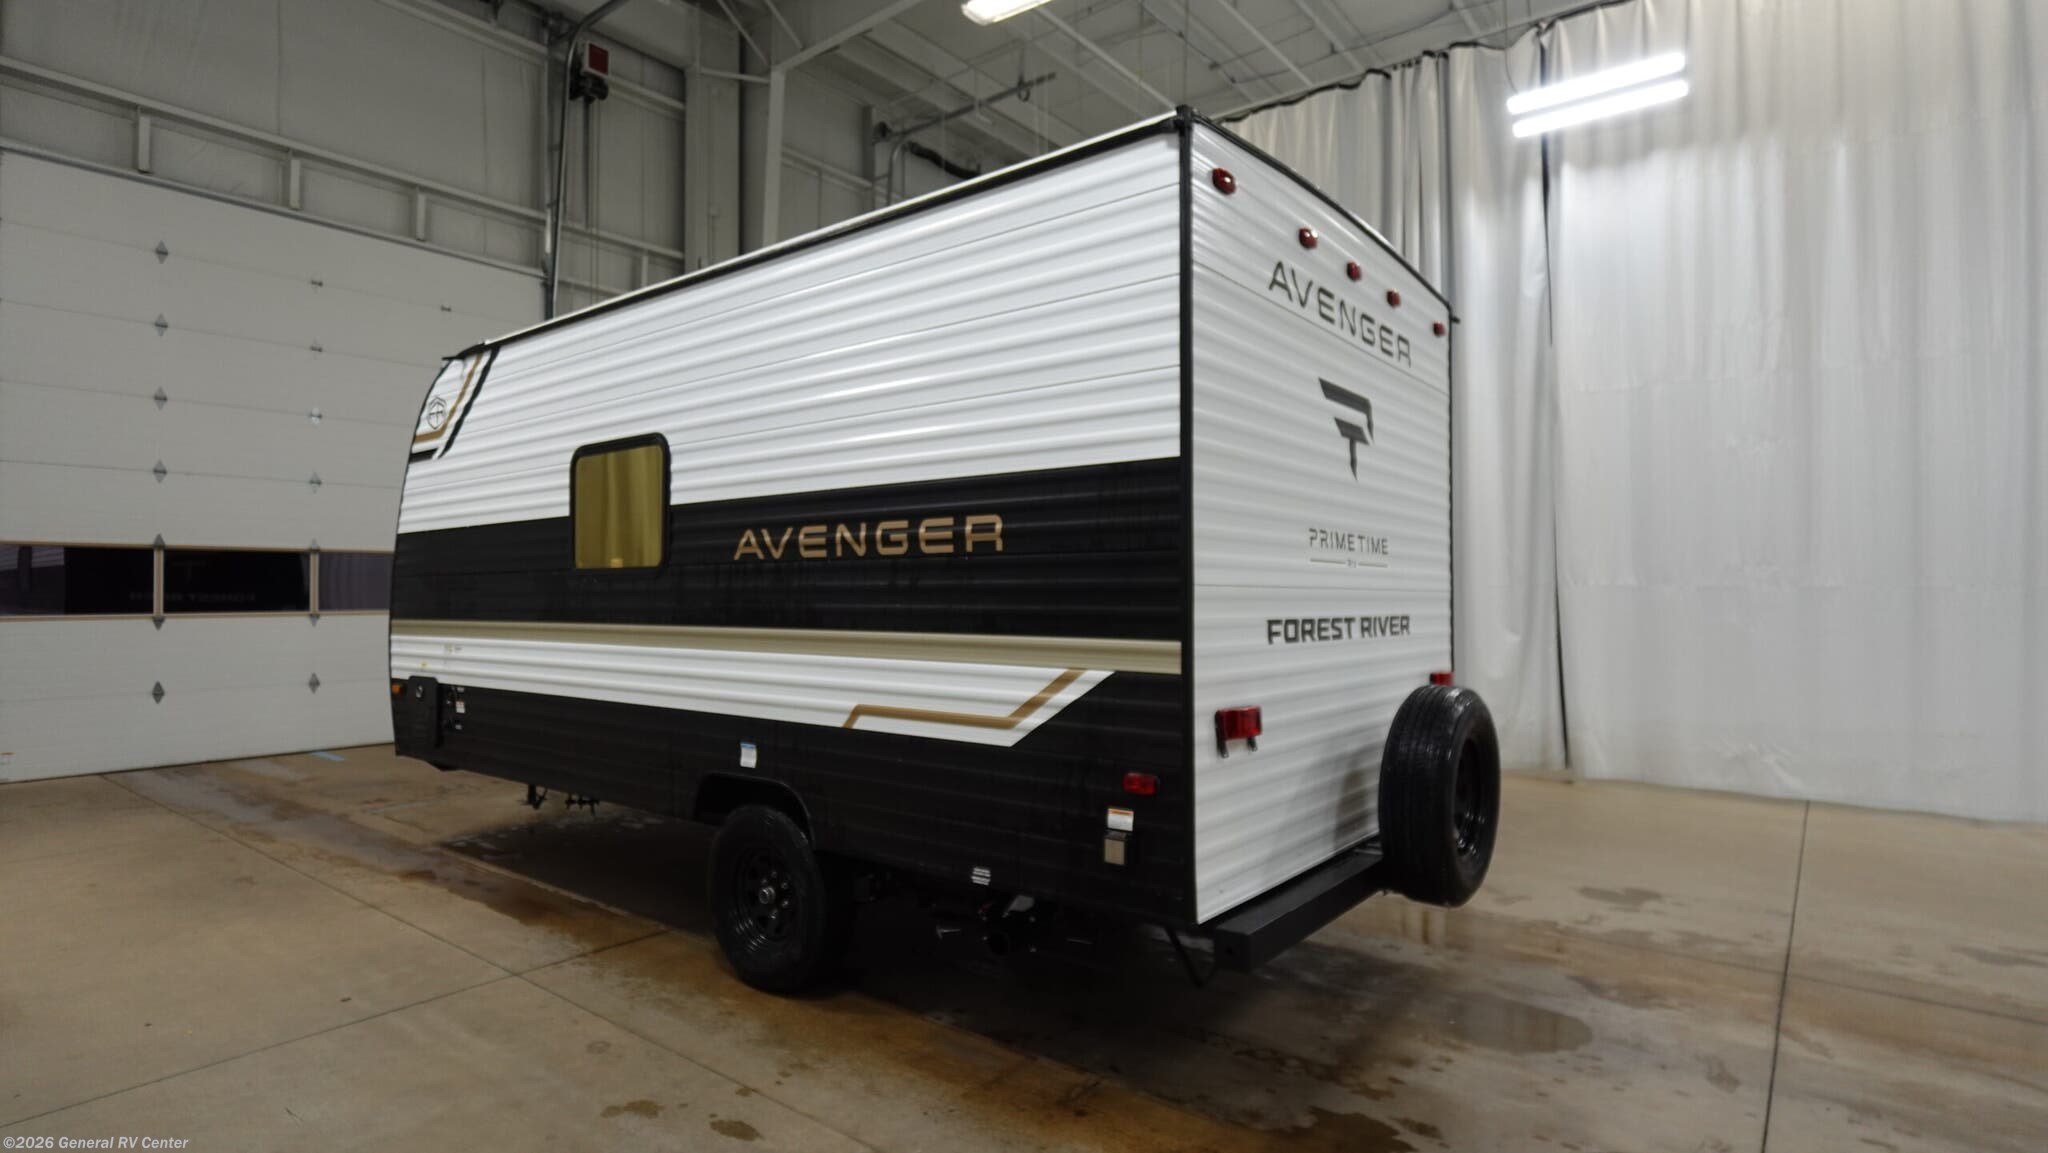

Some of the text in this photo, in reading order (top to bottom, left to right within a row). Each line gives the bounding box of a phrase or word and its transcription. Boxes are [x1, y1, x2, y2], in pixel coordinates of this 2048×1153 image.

[1268, 260, 1413, 368] AVENGER
[733, 513, 1005, 561] AVENGER
[1266, 615, 1411, 645] FOREST RIVER
